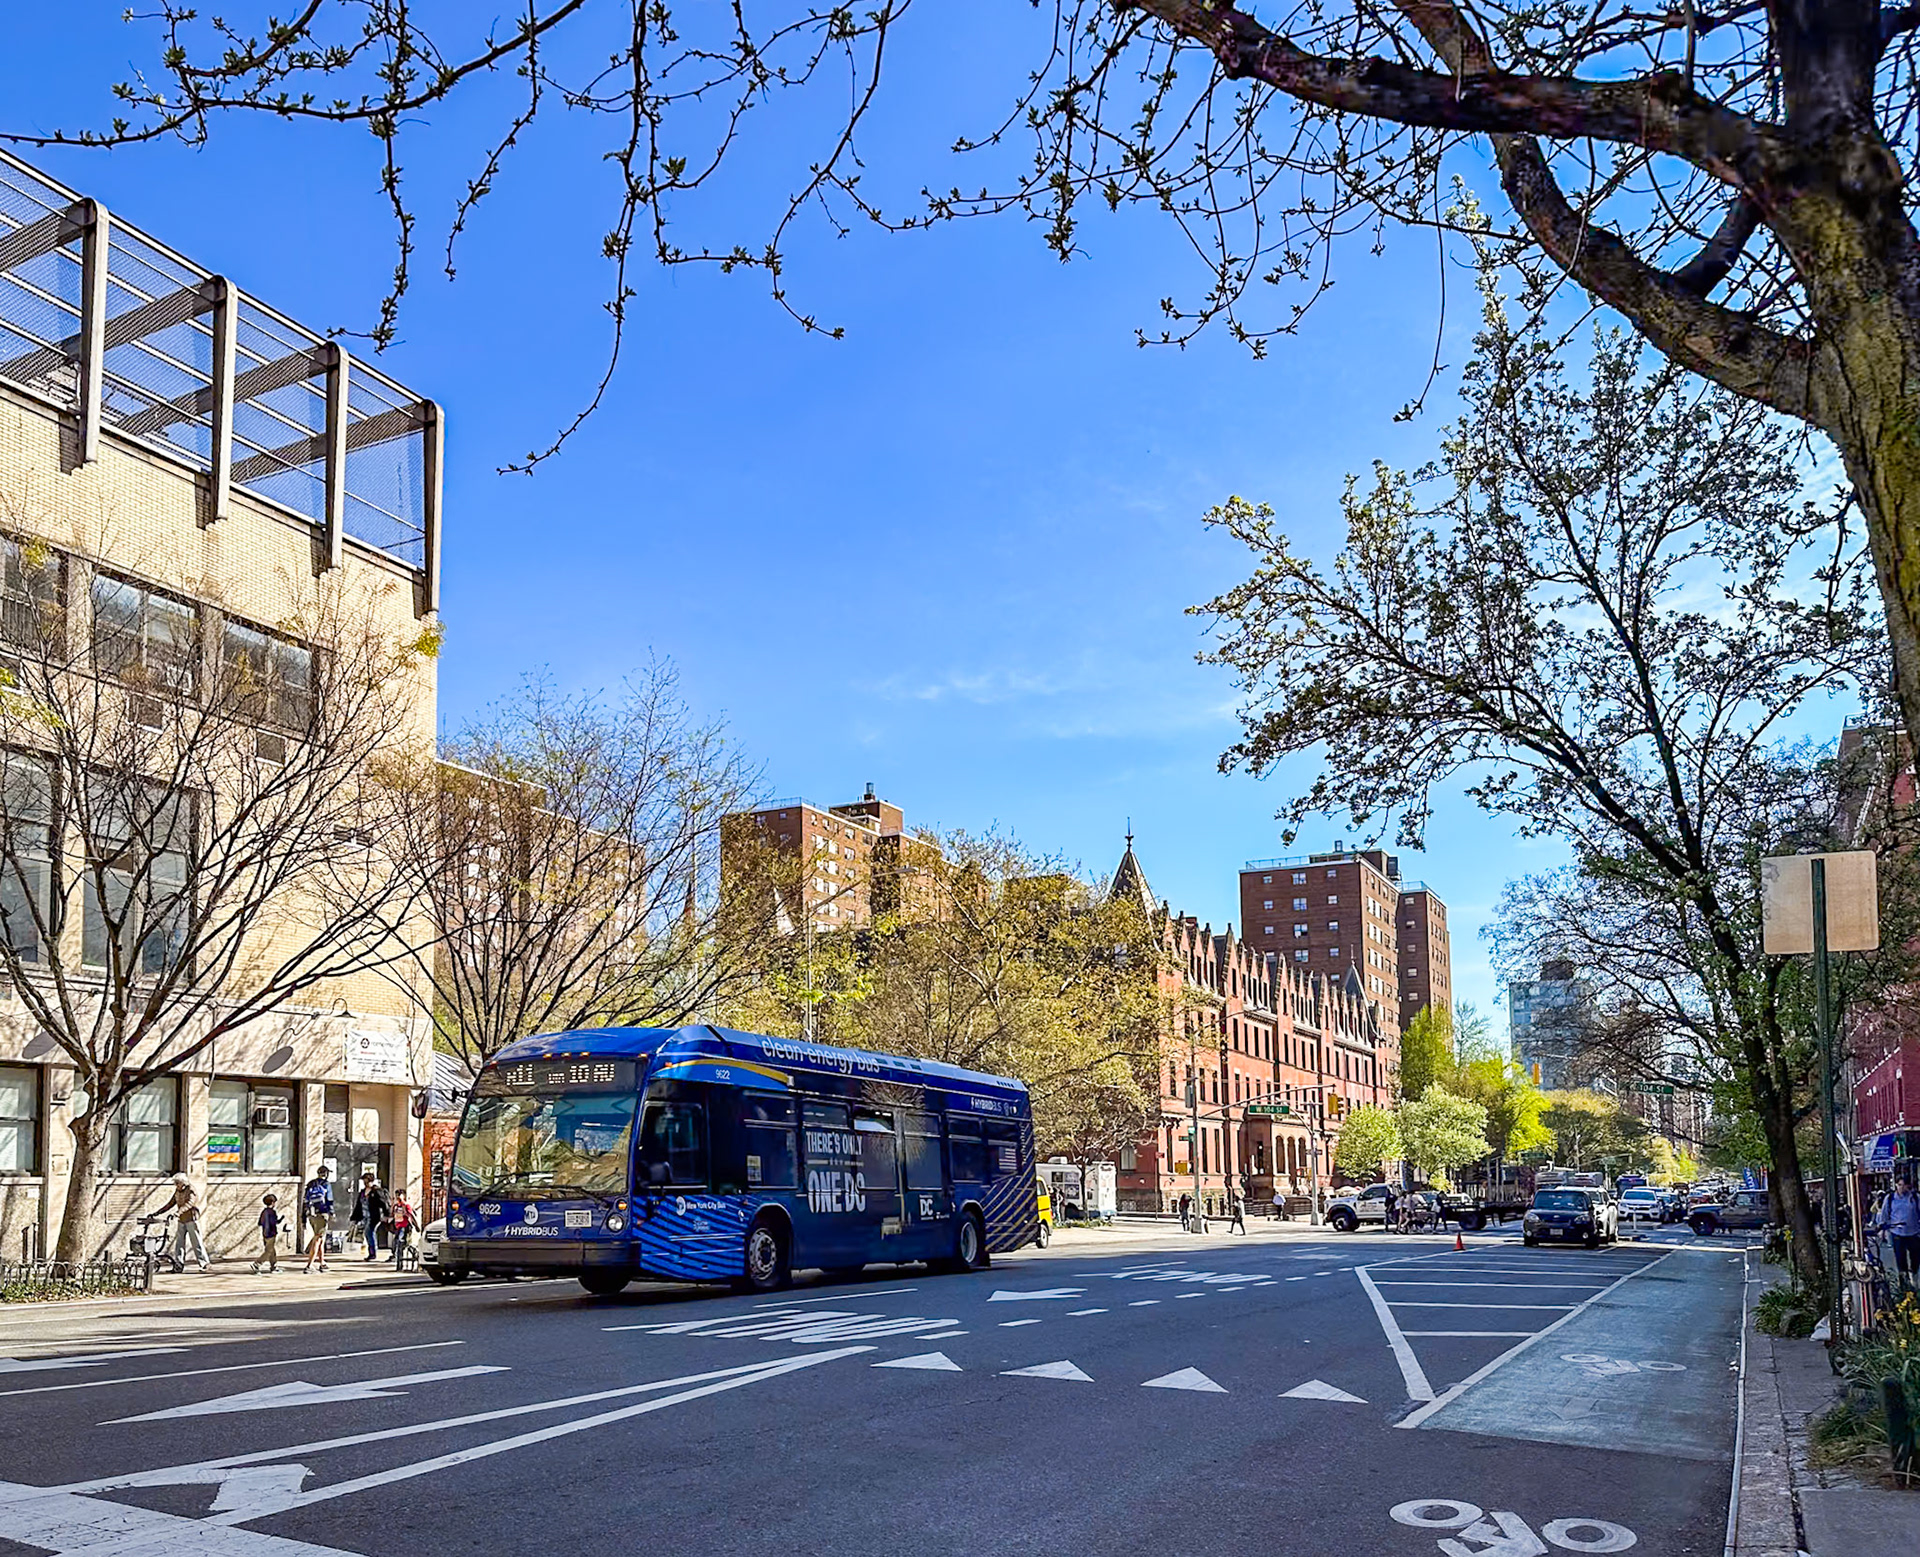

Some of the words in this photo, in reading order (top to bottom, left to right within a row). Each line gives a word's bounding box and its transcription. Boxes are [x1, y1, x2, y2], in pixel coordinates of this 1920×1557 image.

[853, 1051, 880, 1073] bus
[806, 1131, 841, 1155] THERE'S
[842, 1133, 863, 1156] ONLY
[808, 1170, 843, 1214] ONE
[844, 1171, 866, 1213] DC
[479, 1203, 501, 1215] 9622
[920, 1198, 934, 1216] DC
[510, 1226, 559, 1237] HYBRIDBUS
